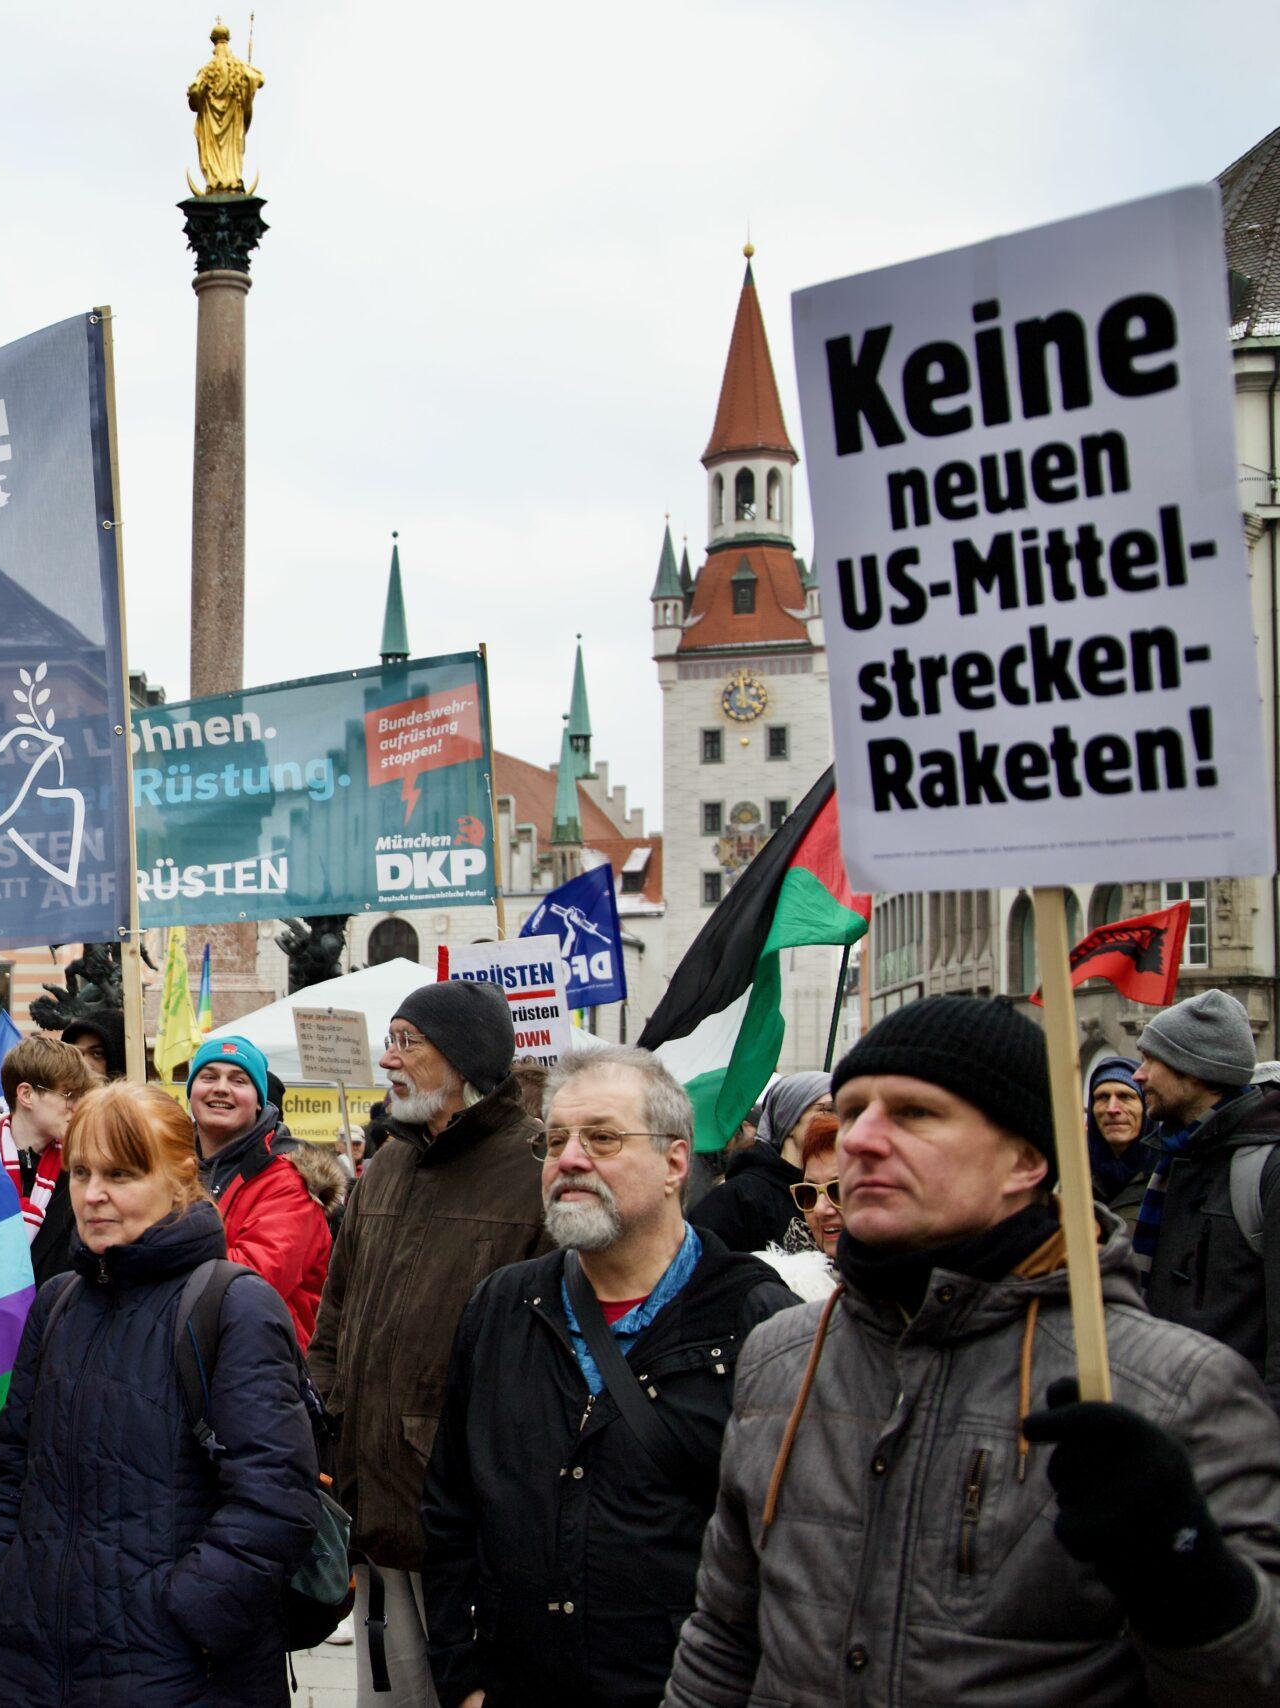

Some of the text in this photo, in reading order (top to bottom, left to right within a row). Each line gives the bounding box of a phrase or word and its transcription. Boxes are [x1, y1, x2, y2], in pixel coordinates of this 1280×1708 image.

[825, 292, 1180, 458] Keine
[887, 428, 1131, 531] neuen
[836, 504, 1218, 632] US-Mittel-
[857, 624, 1212, 722] strecken-
[378, 699, 474, 733] Bundeswehr-
[380, 720, 458, 751] aufrüstung
[381, 739, 443, 768] stoppen!
[867, 706, 1218, 813] Raketen!
[133, 758, 351, 807] Rüstung.
[375, 832, 451, 850] München
[376, 848, 487, 891] DKP
[378, 893, 408, 902] Deutsche
[465, 889, 487, 897] Partei
[512, 1005, 559, 1022] rüsten
[515, 1029, 551, 1049] OWN
[284, 1095, 332, 1114] chten
